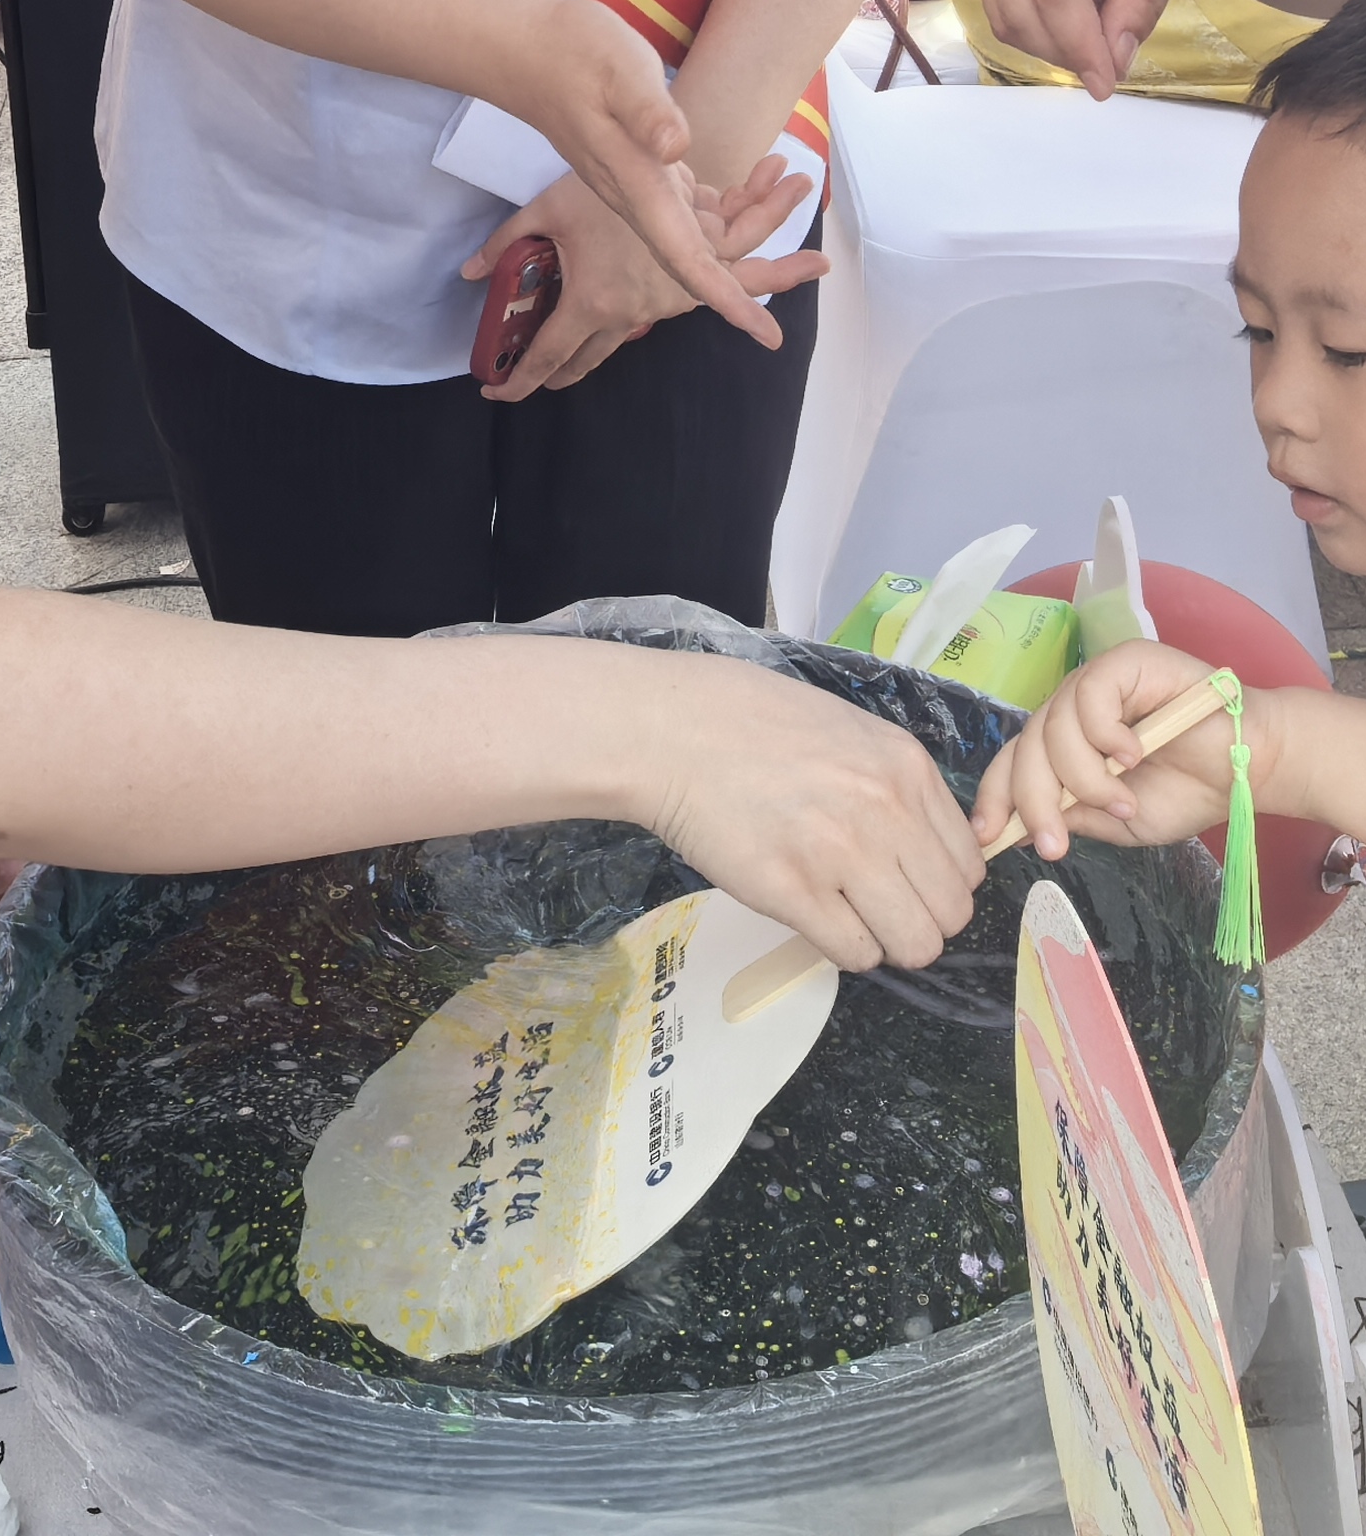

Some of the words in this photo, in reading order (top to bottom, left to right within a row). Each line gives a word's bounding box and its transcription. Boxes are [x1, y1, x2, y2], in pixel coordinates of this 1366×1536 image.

[504, 1021, 553, 1229] 助力美好生活
